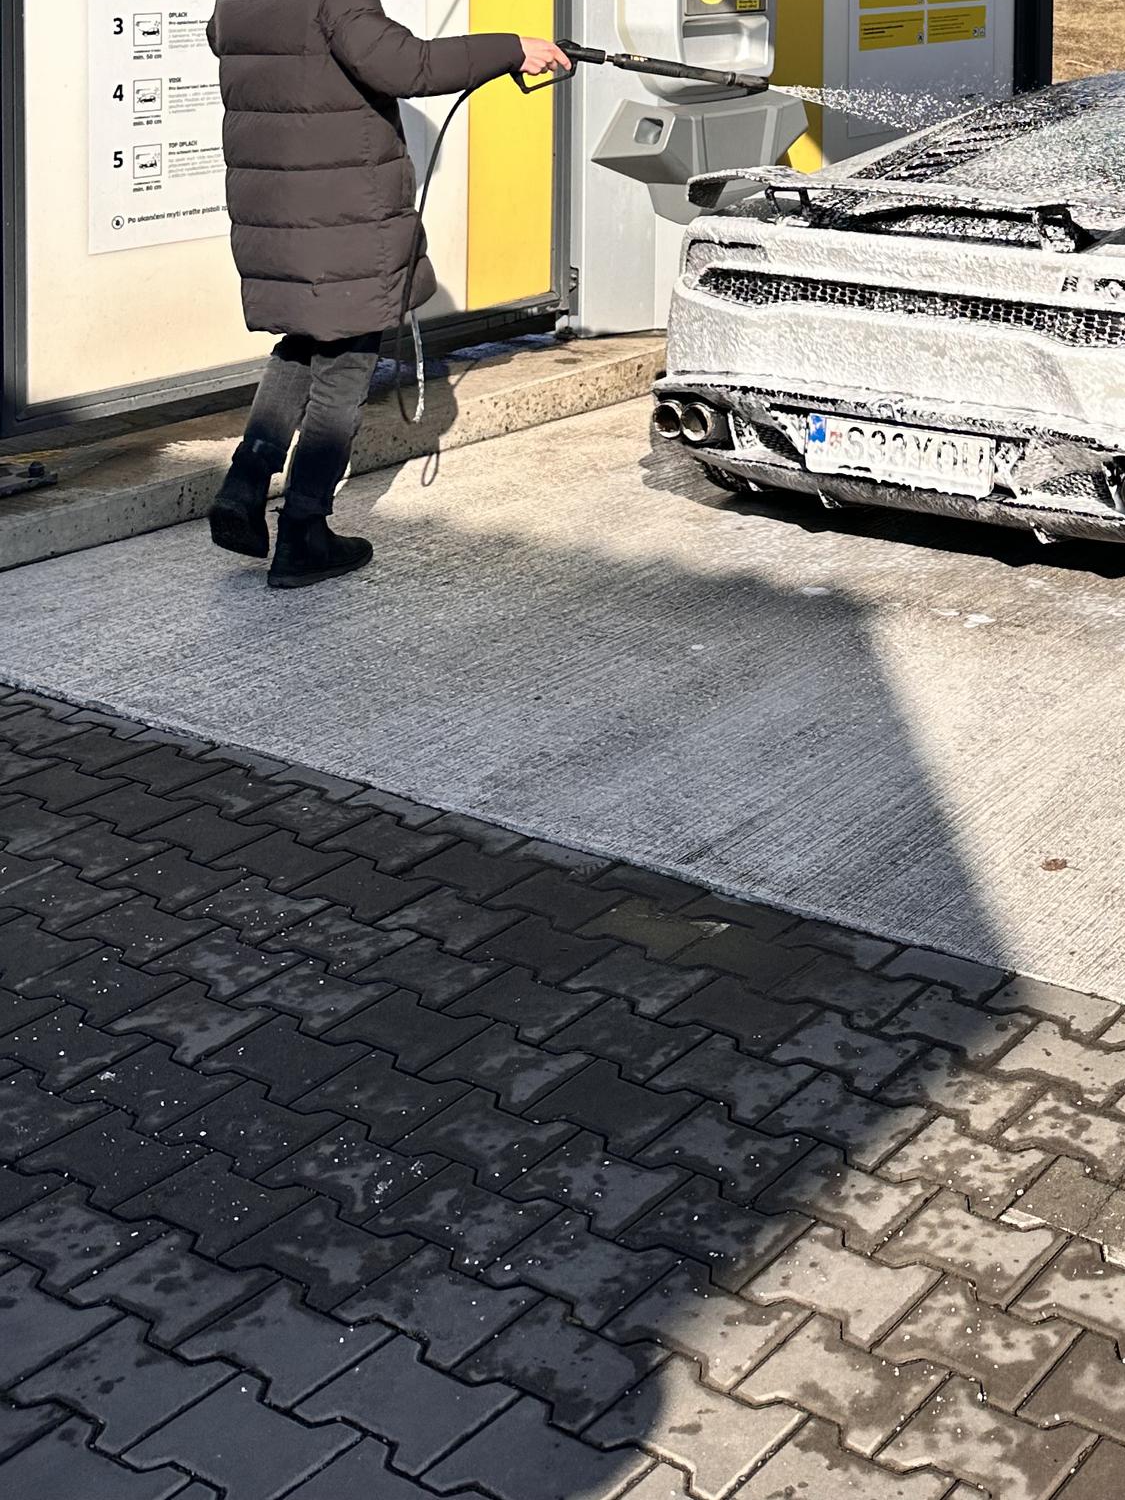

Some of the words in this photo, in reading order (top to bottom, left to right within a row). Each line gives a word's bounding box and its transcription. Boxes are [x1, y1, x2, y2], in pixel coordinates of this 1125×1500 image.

[113, 17, 124, 35] 3
[112, 84, 124, 102] 4
[113, 151, 123, 168] 5
